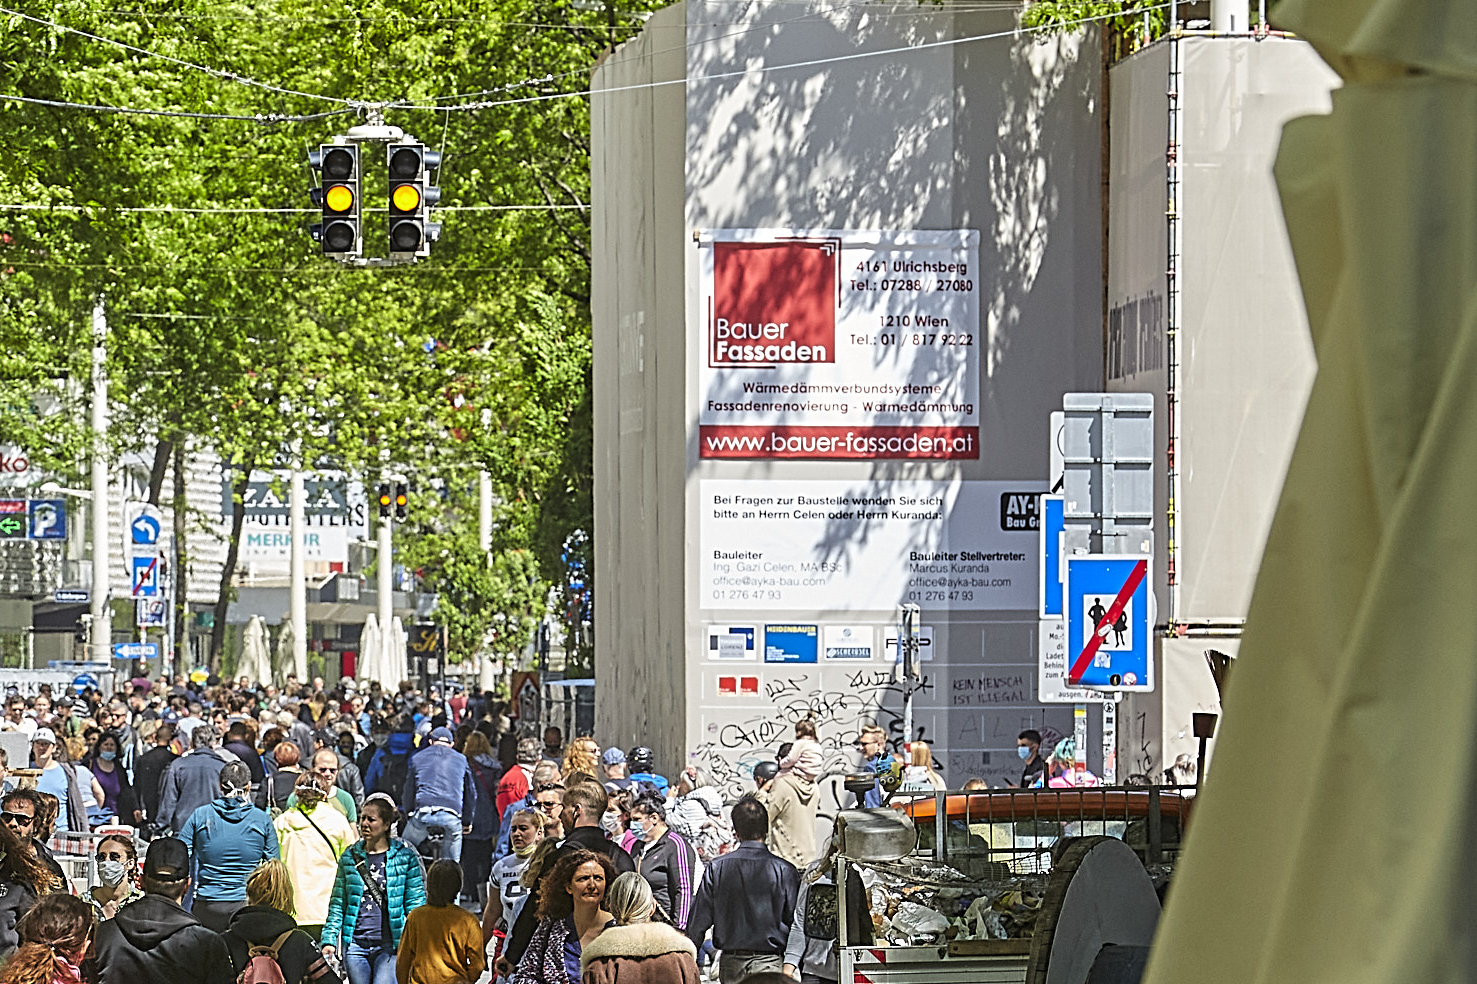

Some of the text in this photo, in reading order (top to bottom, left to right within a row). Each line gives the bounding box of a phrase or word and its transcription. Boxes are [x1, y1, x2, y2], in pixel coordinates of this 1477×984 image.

[857, 261, 967, 276] 4161 Ulrichsberg
[851, 279, 877, 292] Tel.:
[881, 280, 922, 292] 07288
[937, 279, 973, 292] 27080
[879, 315, 949, 328] 1210 Wien
[717, 318, 789, 340] Bauer
[851, 334, 877, 346] Tel.:
[881, 335, 896, 346] 01
[913, 335, 936, 346] 817
[717, 341, 826, 362] Fassaden
[743, 381, 942, 396] Wärmedämmverbundsysteme
[708, 401, 848, 415] Fassadenrenovierung
[863, 400, 974, 415] Wärmedämmung
[707, 432, 974, 453] www.bauer-fassaden.at
[714, 496, 731, 505] Bei
[735, 496, 774, 507] Fragen
[798, 496, 848, 505] Baustelle
[852, 497, 895, 506] wenden
[899, 497, 917, 506] Sie
[920, 497, 943, 506] sich
[1006, 496, 1040, 515] AY-
[714, 510, 738, 519] bitte
[759, 510, 790, 519] Herrn
[793, 510, 824, 519] Celen
[828, 511, 853, 520] oder
[857, 511, 888, 520] Herrn
[892, 511, 943, 520] Kuranda:
[1006, 517, 1025, 528] Bau
[714, 551, 763, 560] Bauleiter
[910, 552, 1025, 561] Bauleiter Stellvertreter:
[736, 563, 760, 572] Gazi
[801, 563, 818, 572] MA
[910, 564, 989, 573] Marcus Kuranda
[713, 577, 825, 587] office@ayka-bau.com
[909, 578, 1011, 588] office@ayka-bau.com
[713, 590, 781, 599] 01 276 47 93
[909, 591, 973, 600] 01 276 47 93
[953, 676, 1023, 691] KEIN MENSCH
[953, 691, 1024, 705] IST ILLEGAL
